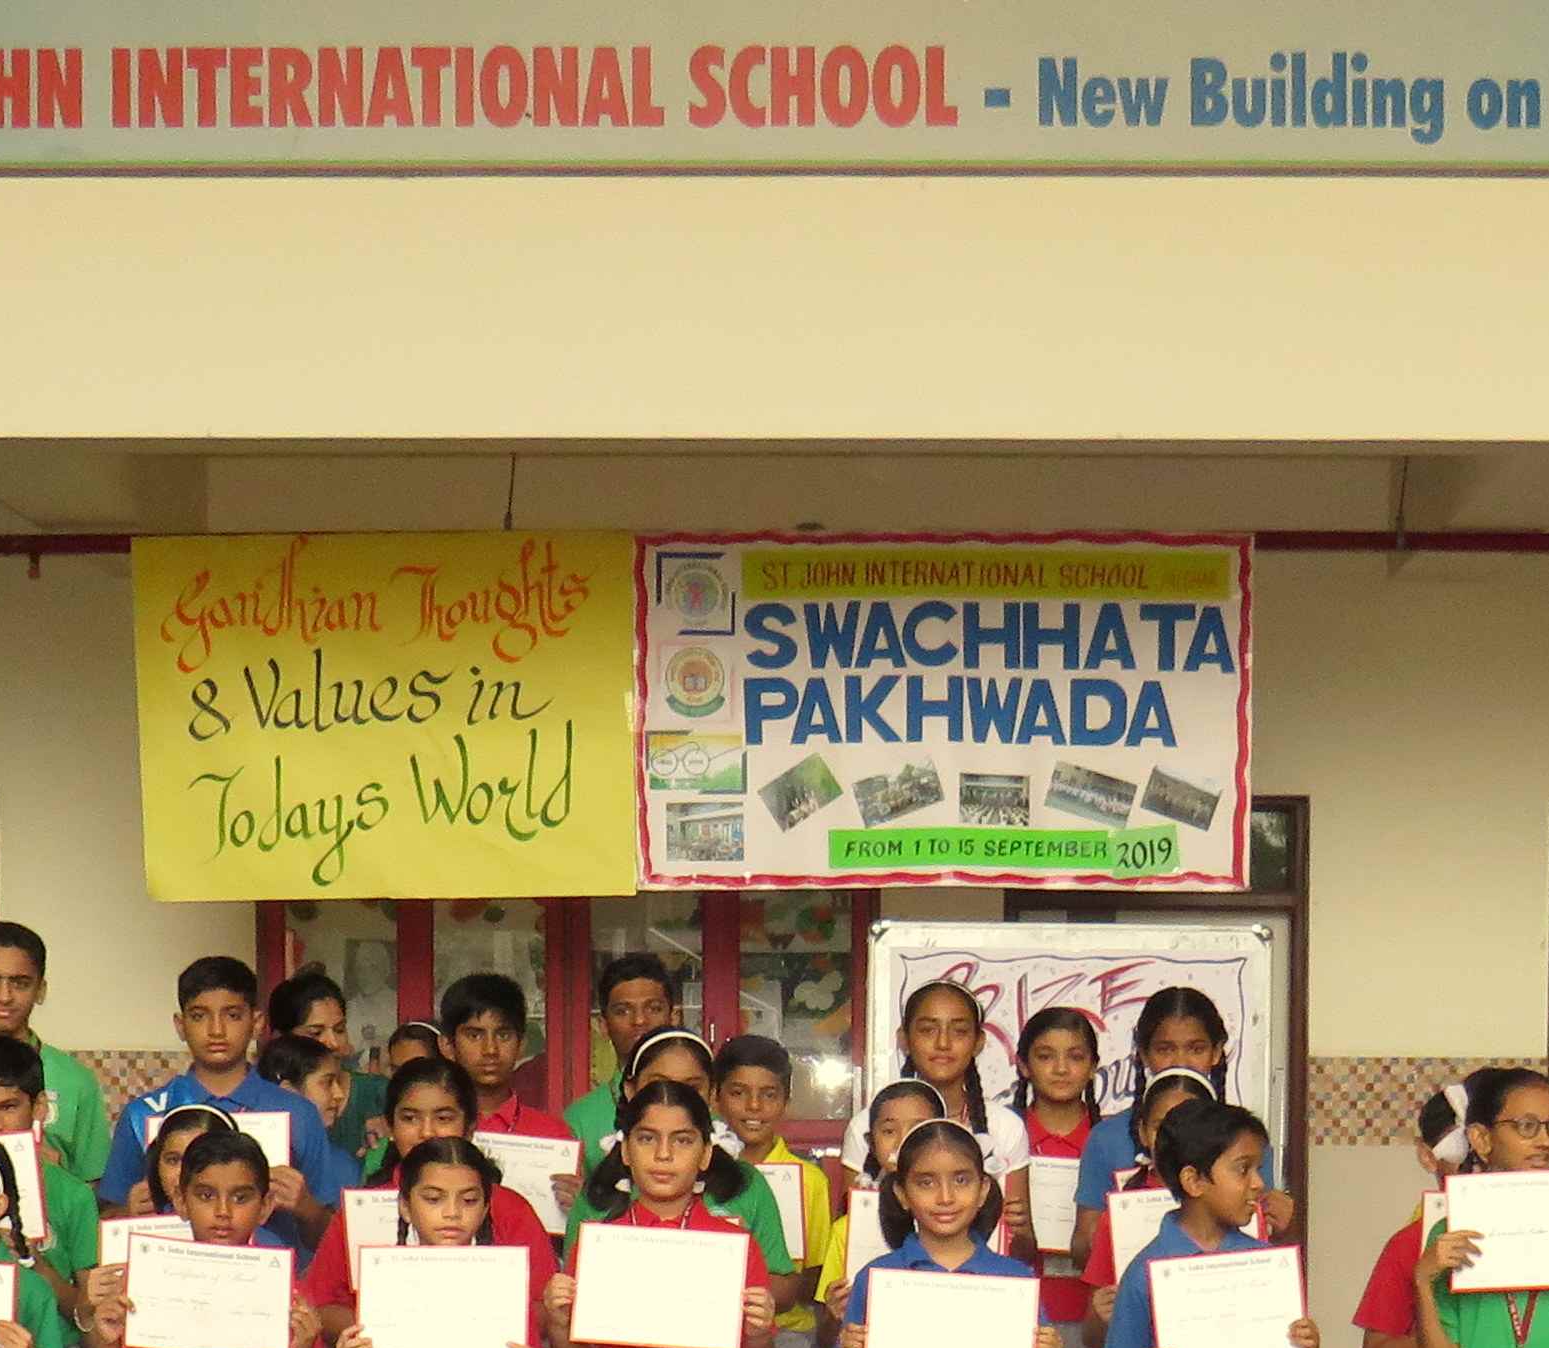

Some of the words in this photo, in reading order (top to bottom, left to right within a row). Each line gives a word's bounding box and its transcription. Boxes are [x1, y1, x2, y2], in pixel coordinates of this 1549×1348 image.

[112, 44, 665, 130] INTERNATIONAL
[688, 42, 958, 129] SCHOOL
[1036, 56, 1167, 130] New
[1189, 50, 1445, 145] Building
[1465, 72, 1541, 131] on
[390, 537, 602, 664] Thoughts
[804, 560, 854, 587] JOHN
[864, 558, 1047, 591] INTERNATIONAL
[1059, 559, 1147, 591] SCHOOL
[743, 600, 1236, 673] SWACHHATA
[243, 648, 455, 732] Values
[466, 665, 554, 726] in
[742, 675, 1179, 748] PAKHWADA
[188, 755, 390, 887] Todays
[410, 719, 574, 842] World
[845, 839, 903, 859] FROM
[913, 838, 921, 857] 1
[927, 838, 951, 856] TO
[957, 837, 975, 857] 15
[983, 838, 1108, 860] SEPTEMBER
[1115, 836, 1173, 870] 2019
